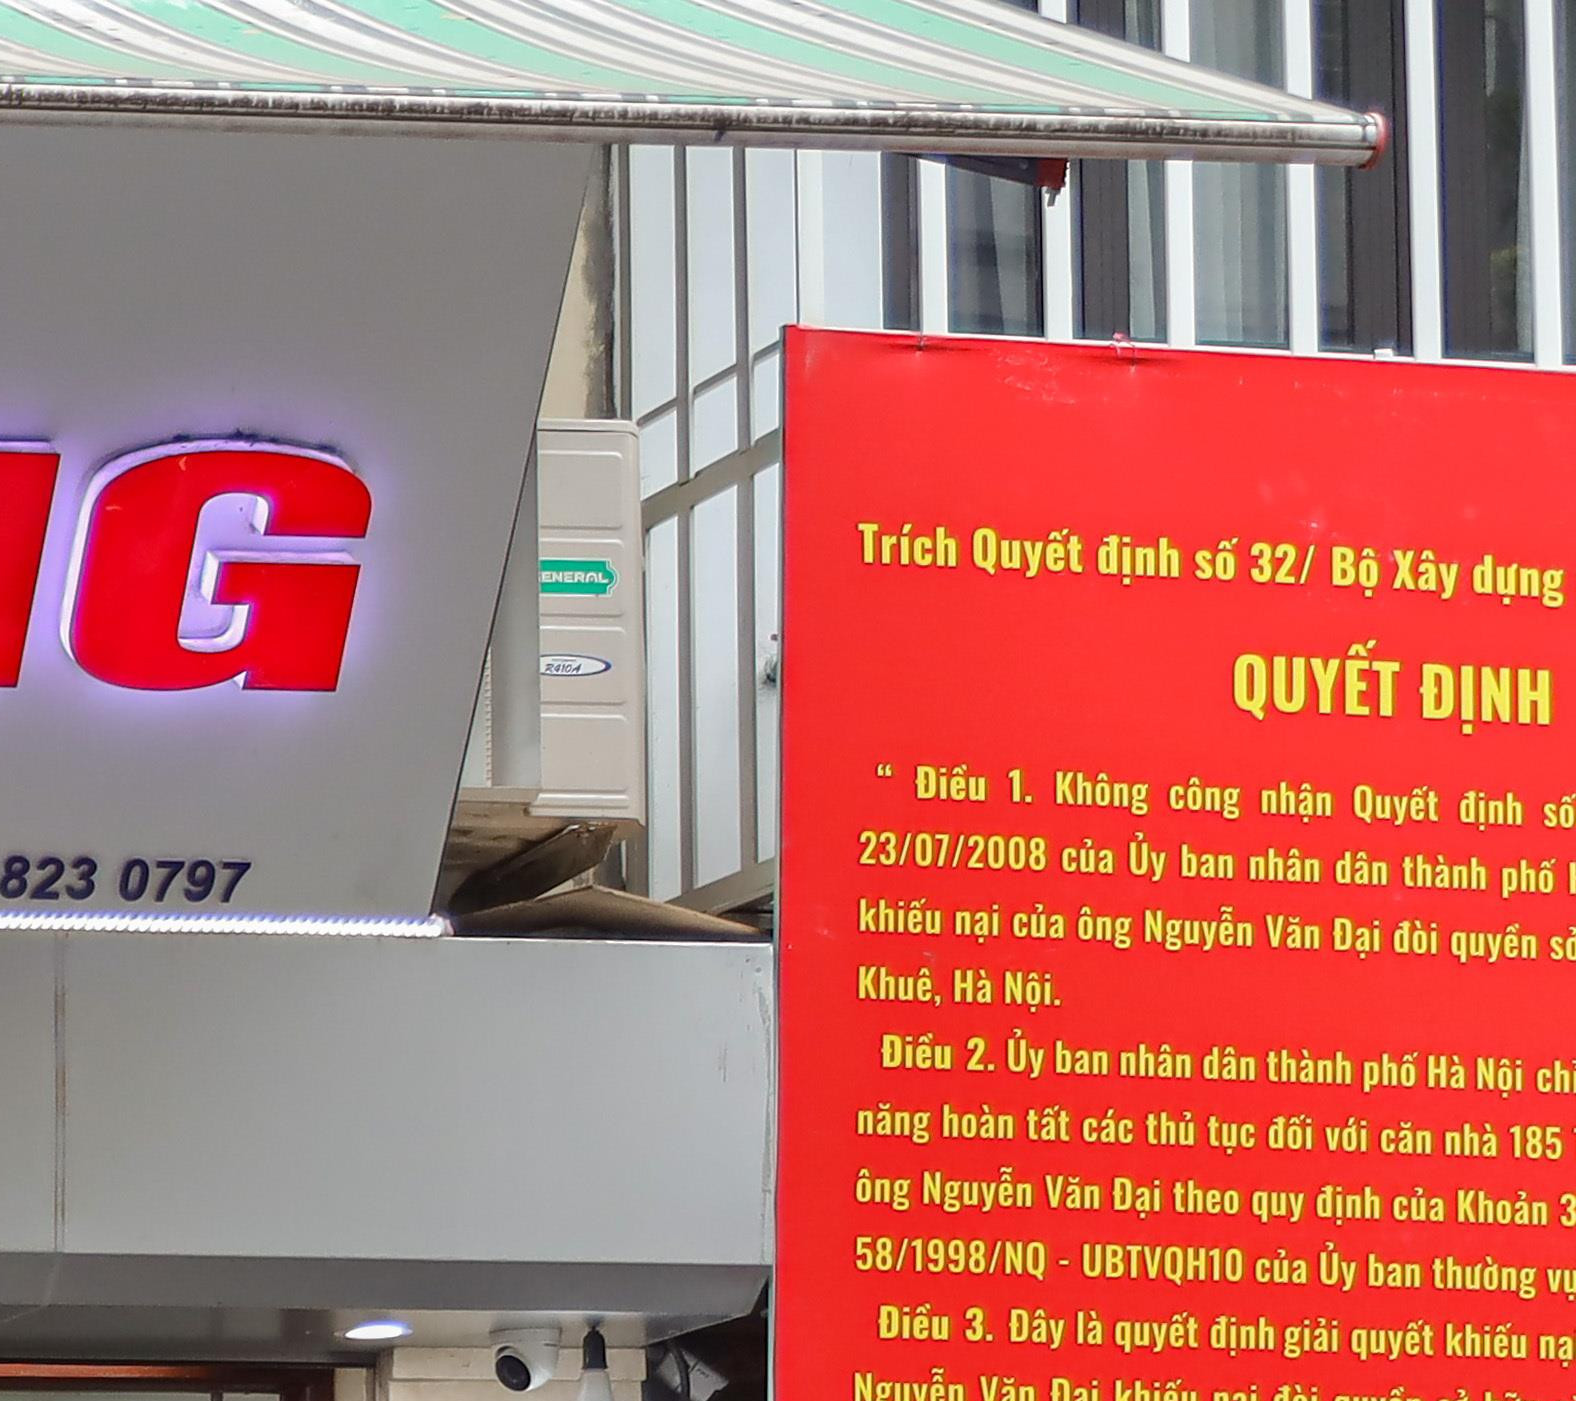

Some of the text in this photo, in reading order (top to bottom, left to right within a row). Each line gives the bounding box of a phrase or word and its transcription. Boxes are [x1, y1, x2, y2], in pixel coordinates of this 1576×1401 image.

[856, 521, 1567, 609] Trích Quyết định số 32/ Bộ Xây dựng
[1232, 638, 1555, 736] QUYẾT ĐỊNH
[914, 762, 990, 802] Điều
[1007, 767, 1034, 804] 1.
[1054, 769, 1150, 817] Không
[1168, 775, 1242, 821] công
[1260, 779, 1334, 824] nhận
[1352, 783, 1440, 827] Quyết
[1458, 788, 1526, 832] định
[1542, 791, 1576, 830] số
[117, 856, 254, 905] 0797
[858, 829, 1558, 900] 23/07/2008 của Ủy ban nhân dân thành phố
[857, 964, 1062, 1014] Khuê, Hà Nội.
[854, 1235, 1047, 1282] 58/1998/NQ
[1081, 1242, 1245, 1287] UBTVQH10
[1254, 1247, 1311, 1285] của
[1318, 1240, 1358, 1293] Ủy
[1367, 1252, 1423, 1289] ban
[1431, 1254, 1538, 1301] thường
